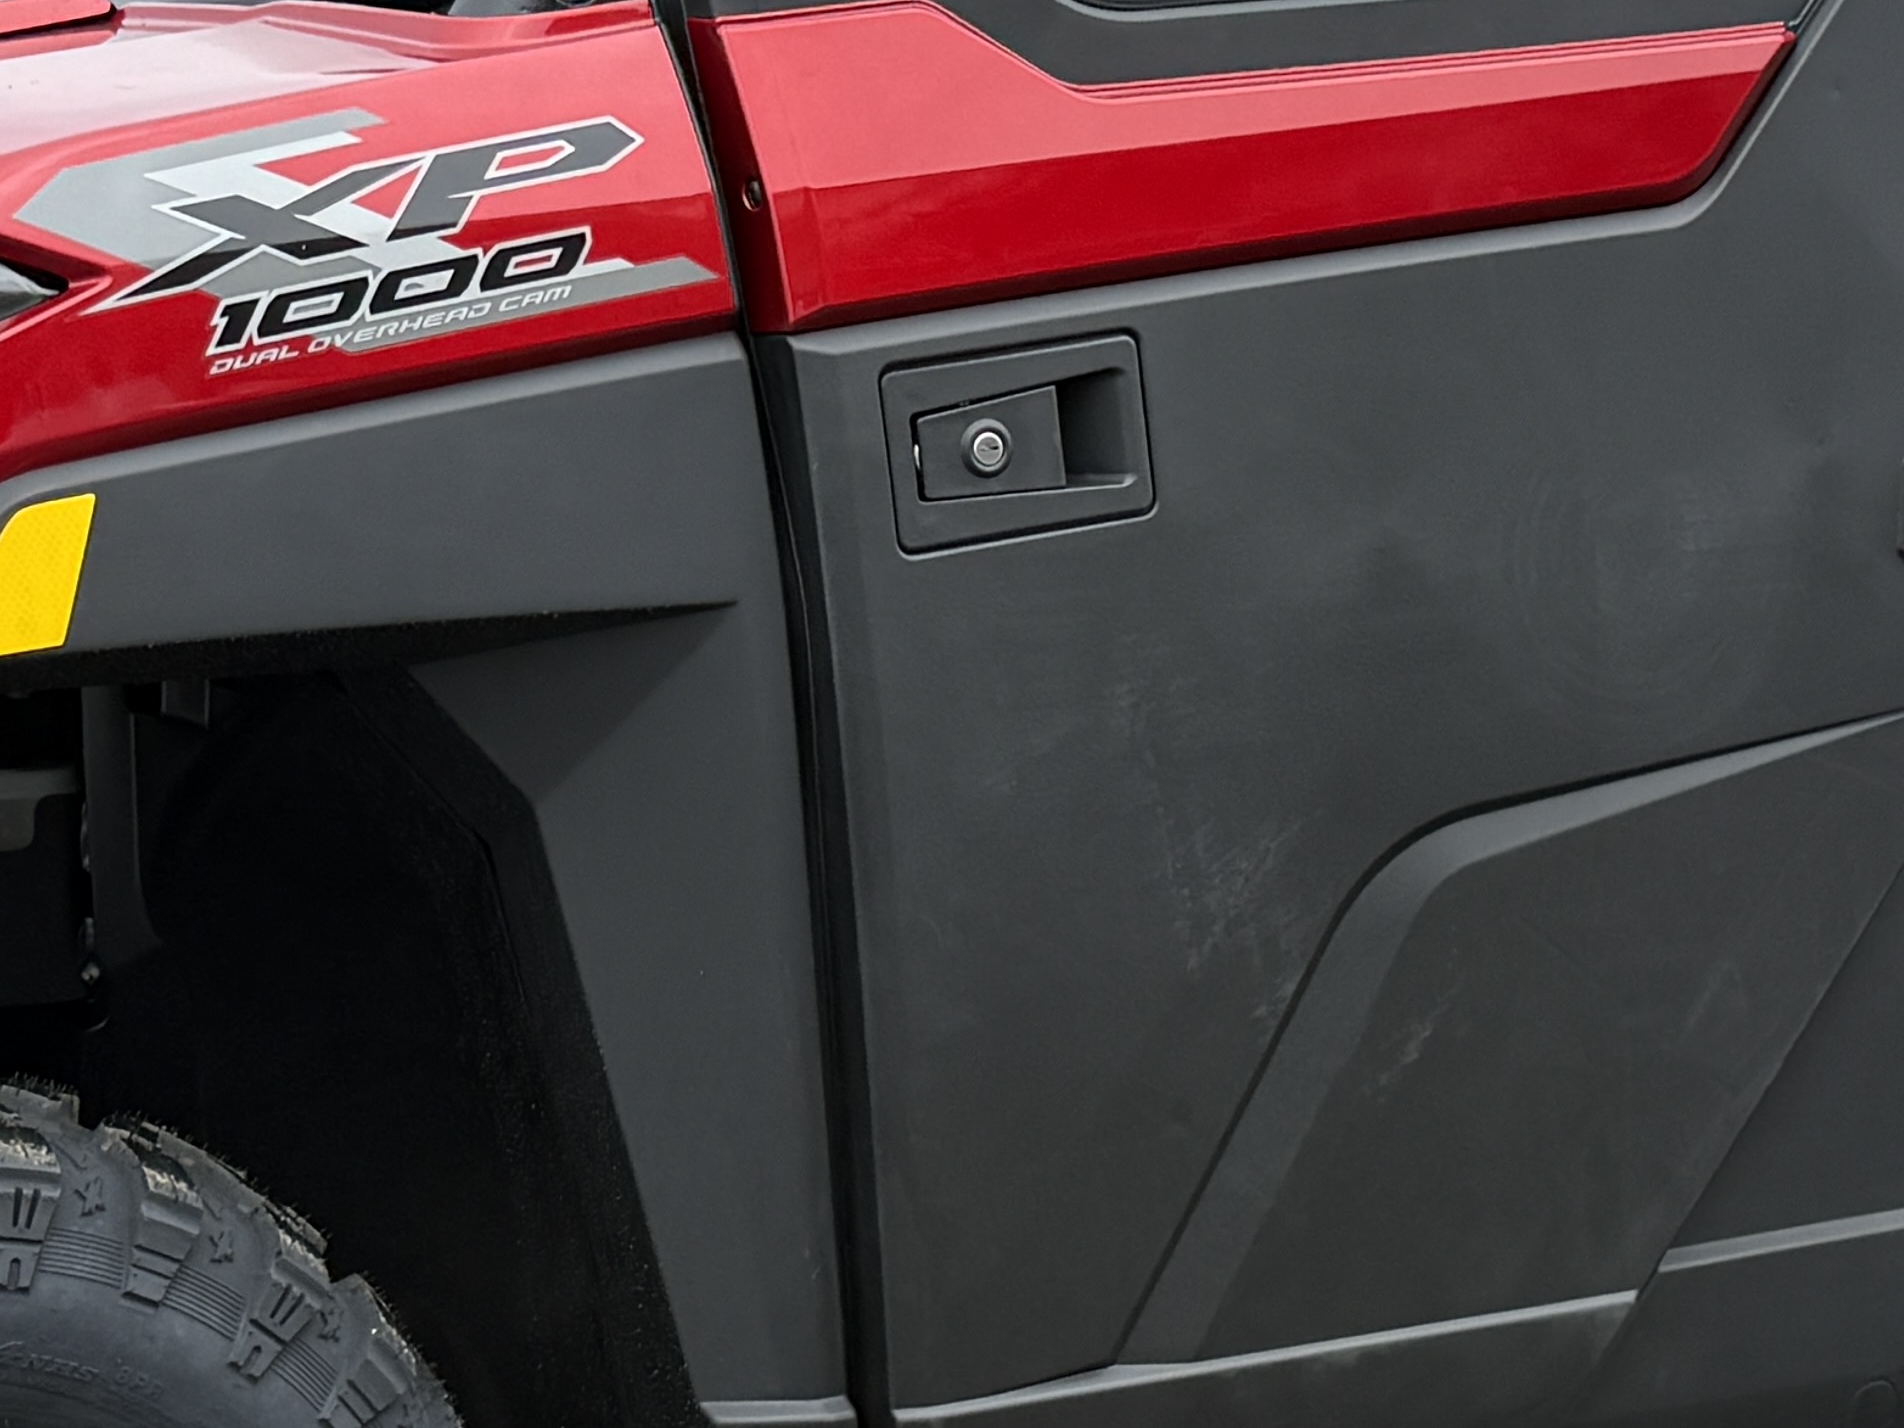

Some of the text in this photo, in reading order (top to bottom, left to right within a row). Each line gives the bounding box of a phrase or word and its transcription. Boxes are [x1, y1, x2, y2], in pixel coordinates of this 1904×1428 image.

[80, 114, 645, 316] XP
[205, 226, 591, 356] 1000
[209, 285, 571, 376] DUAL OVERHEAD CAM
